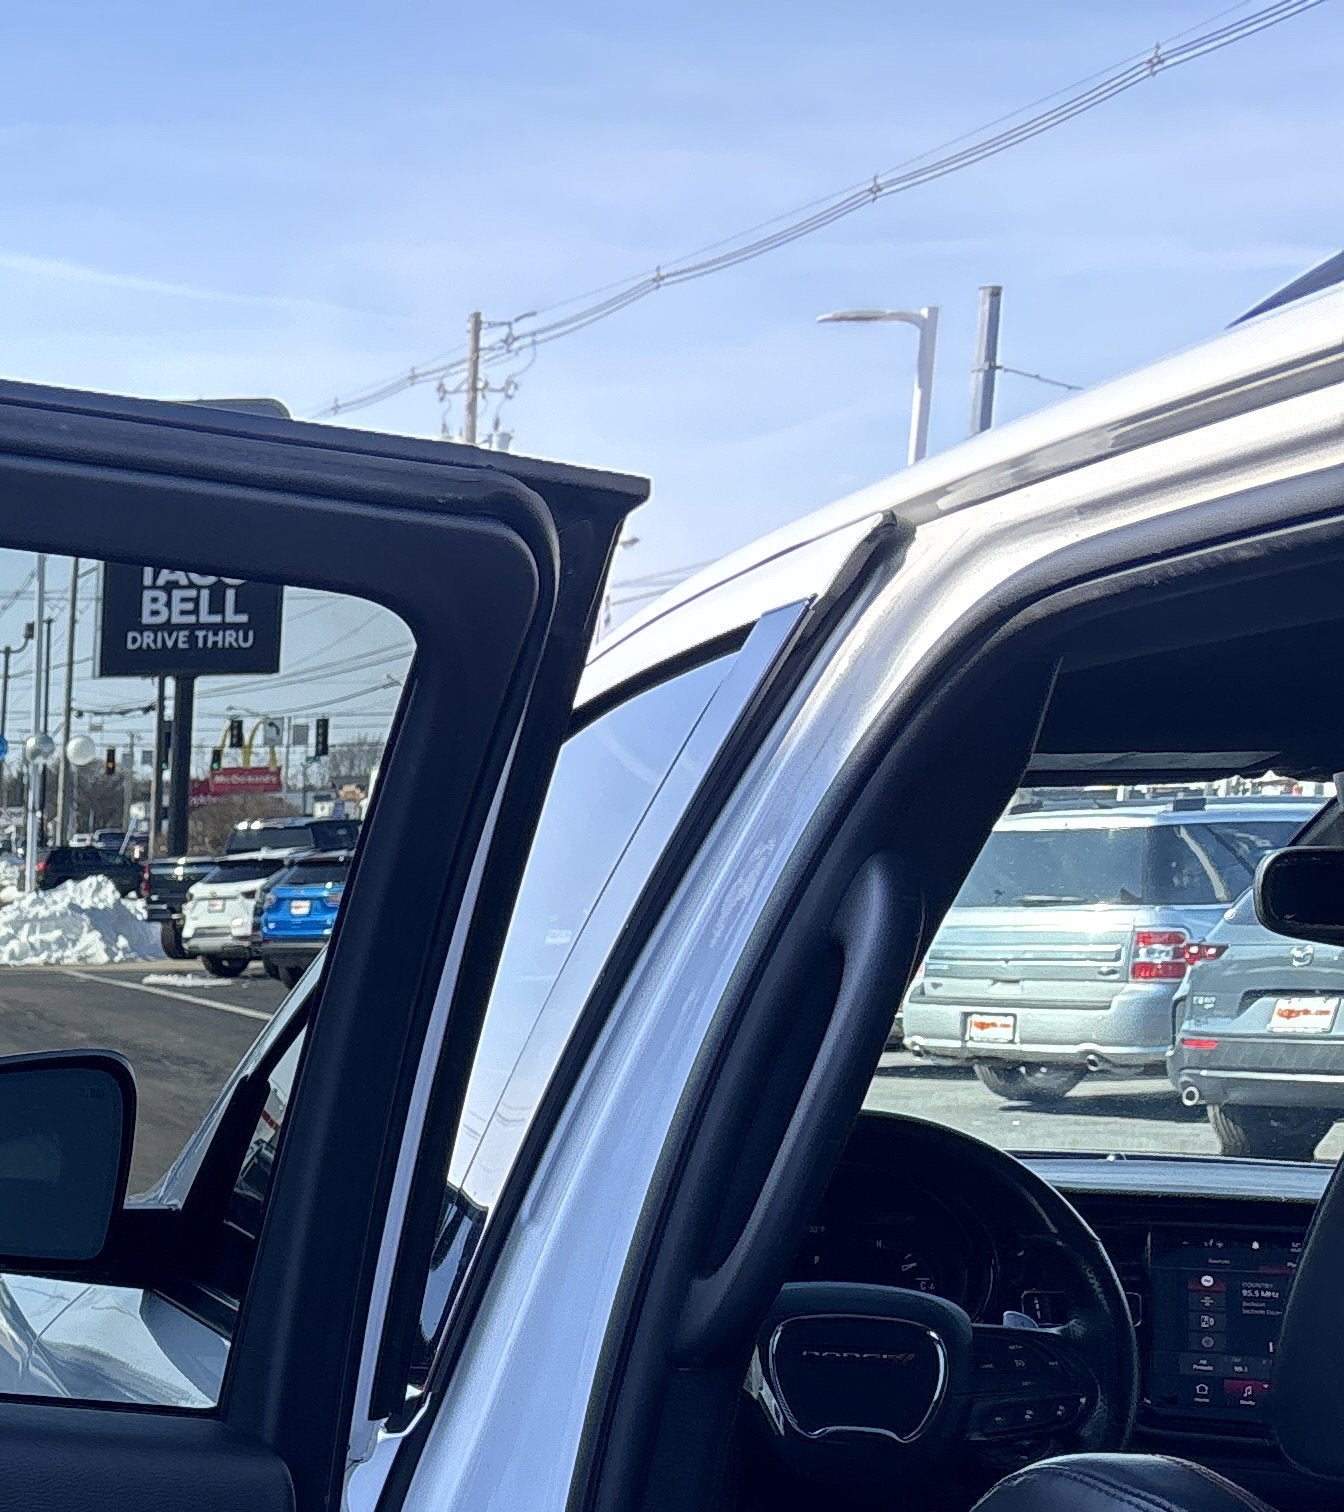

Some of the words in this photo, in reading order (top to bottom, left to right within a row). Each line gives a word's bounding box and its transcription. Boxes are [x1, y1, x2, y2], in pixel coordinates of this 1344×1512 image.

[141, 587, 249, 625] BELL
[126, 629, 190, 650] DRIVE
[194, 629, 254, 649] THRU
